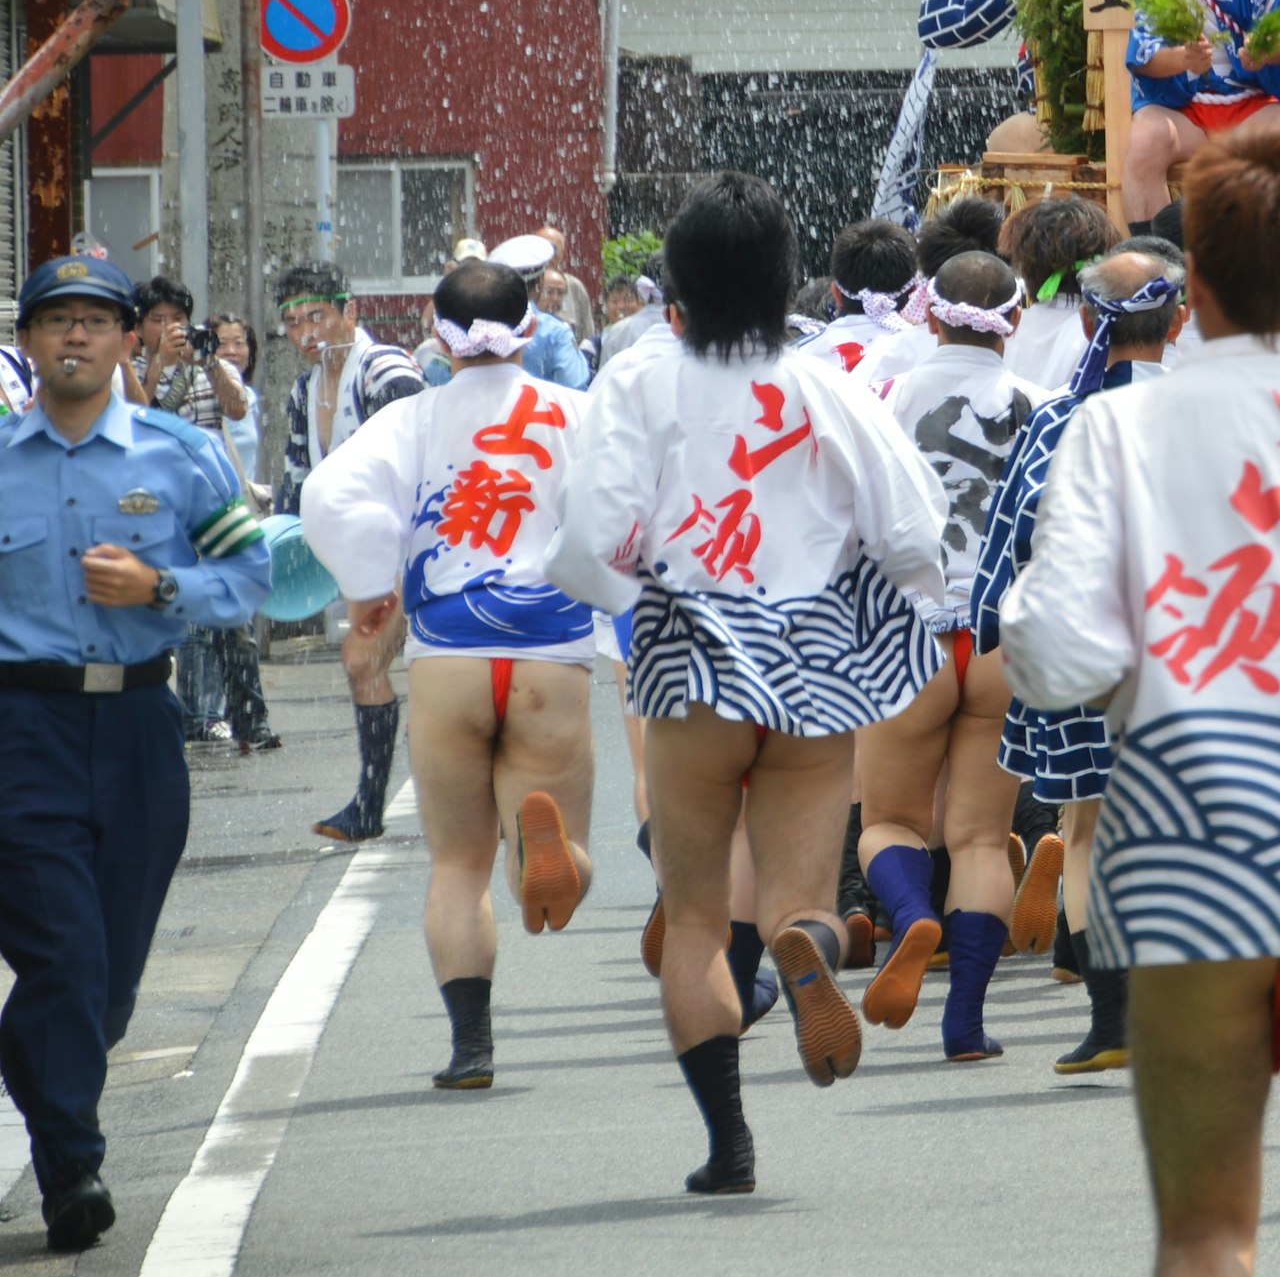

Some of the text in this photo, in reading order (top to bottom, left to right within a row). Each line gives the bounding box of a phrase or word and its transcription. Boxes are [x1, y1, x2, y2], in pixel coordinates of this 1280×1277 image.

[268, 71, 337, 90] 自動車
[436, 383, 566, 557] 上新
